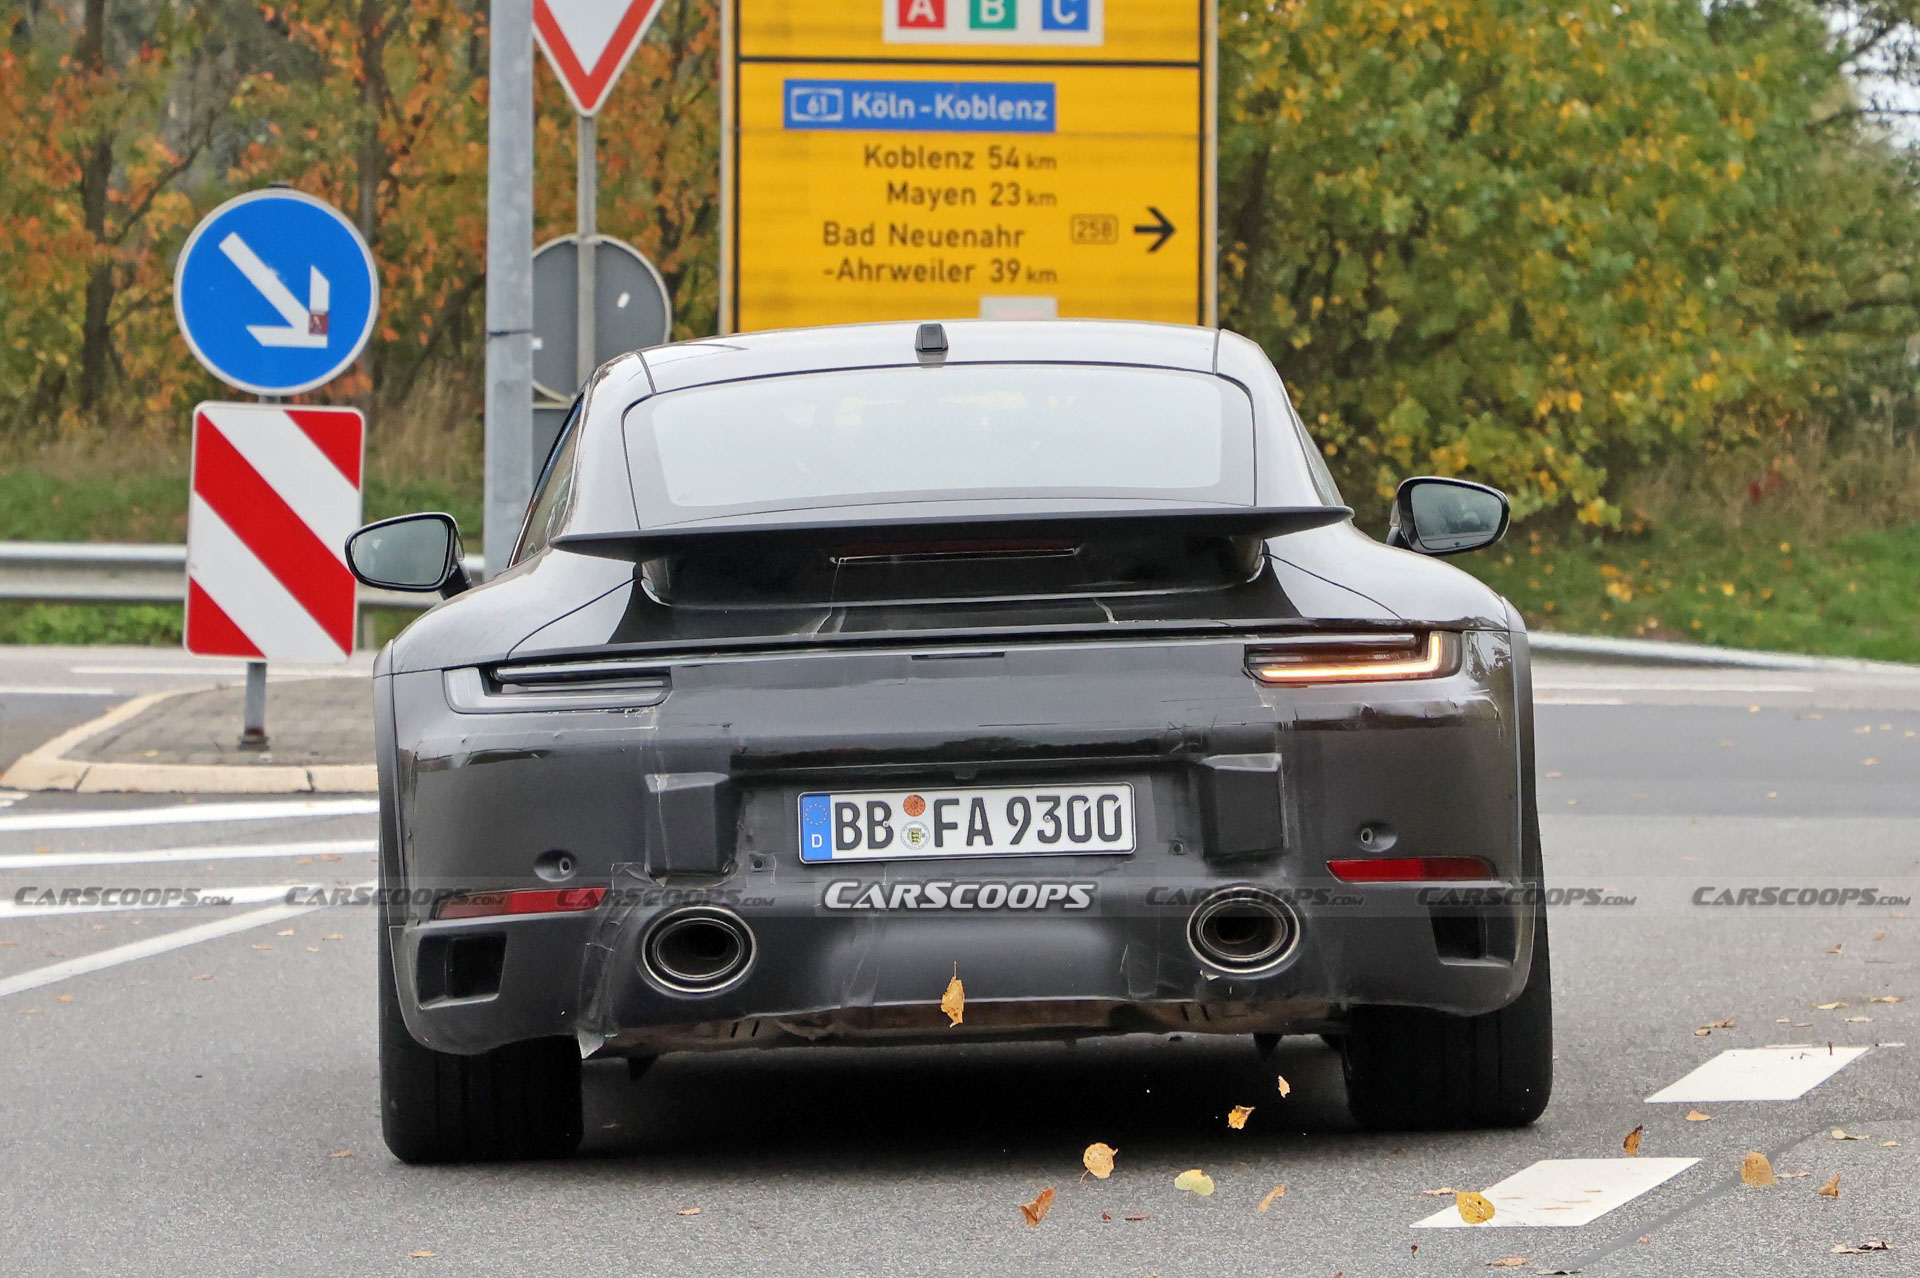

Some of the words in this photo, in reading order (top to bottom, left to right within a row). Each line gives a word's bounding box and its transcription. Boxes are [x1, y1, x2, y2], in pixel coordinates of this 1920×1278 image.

[907, 0, 937, 23] A
[980, 0, 1006, 24] B
[1052, 0, 1078, 25] C
[864, 145, 975, 169] Koblenz
[988, 146, 1020, 170] 54
[1026, 152, 1057, 170] km
[887, 182, 976, 211] Mayen
[990, 183, 1020, 207] 23
[1026, 189, 1057, 207] km
[823, 222, 875, 247] Bad
[889, 223, 1025, 248] Neuenahr
[823, 259, 975, 284] -Ahrweiler
[990, 260, 1020, 284] 39
[1026, 266, 1057, 284] km
[835, 801, 894, 851] BB
[811, 833, 824, 849] D
